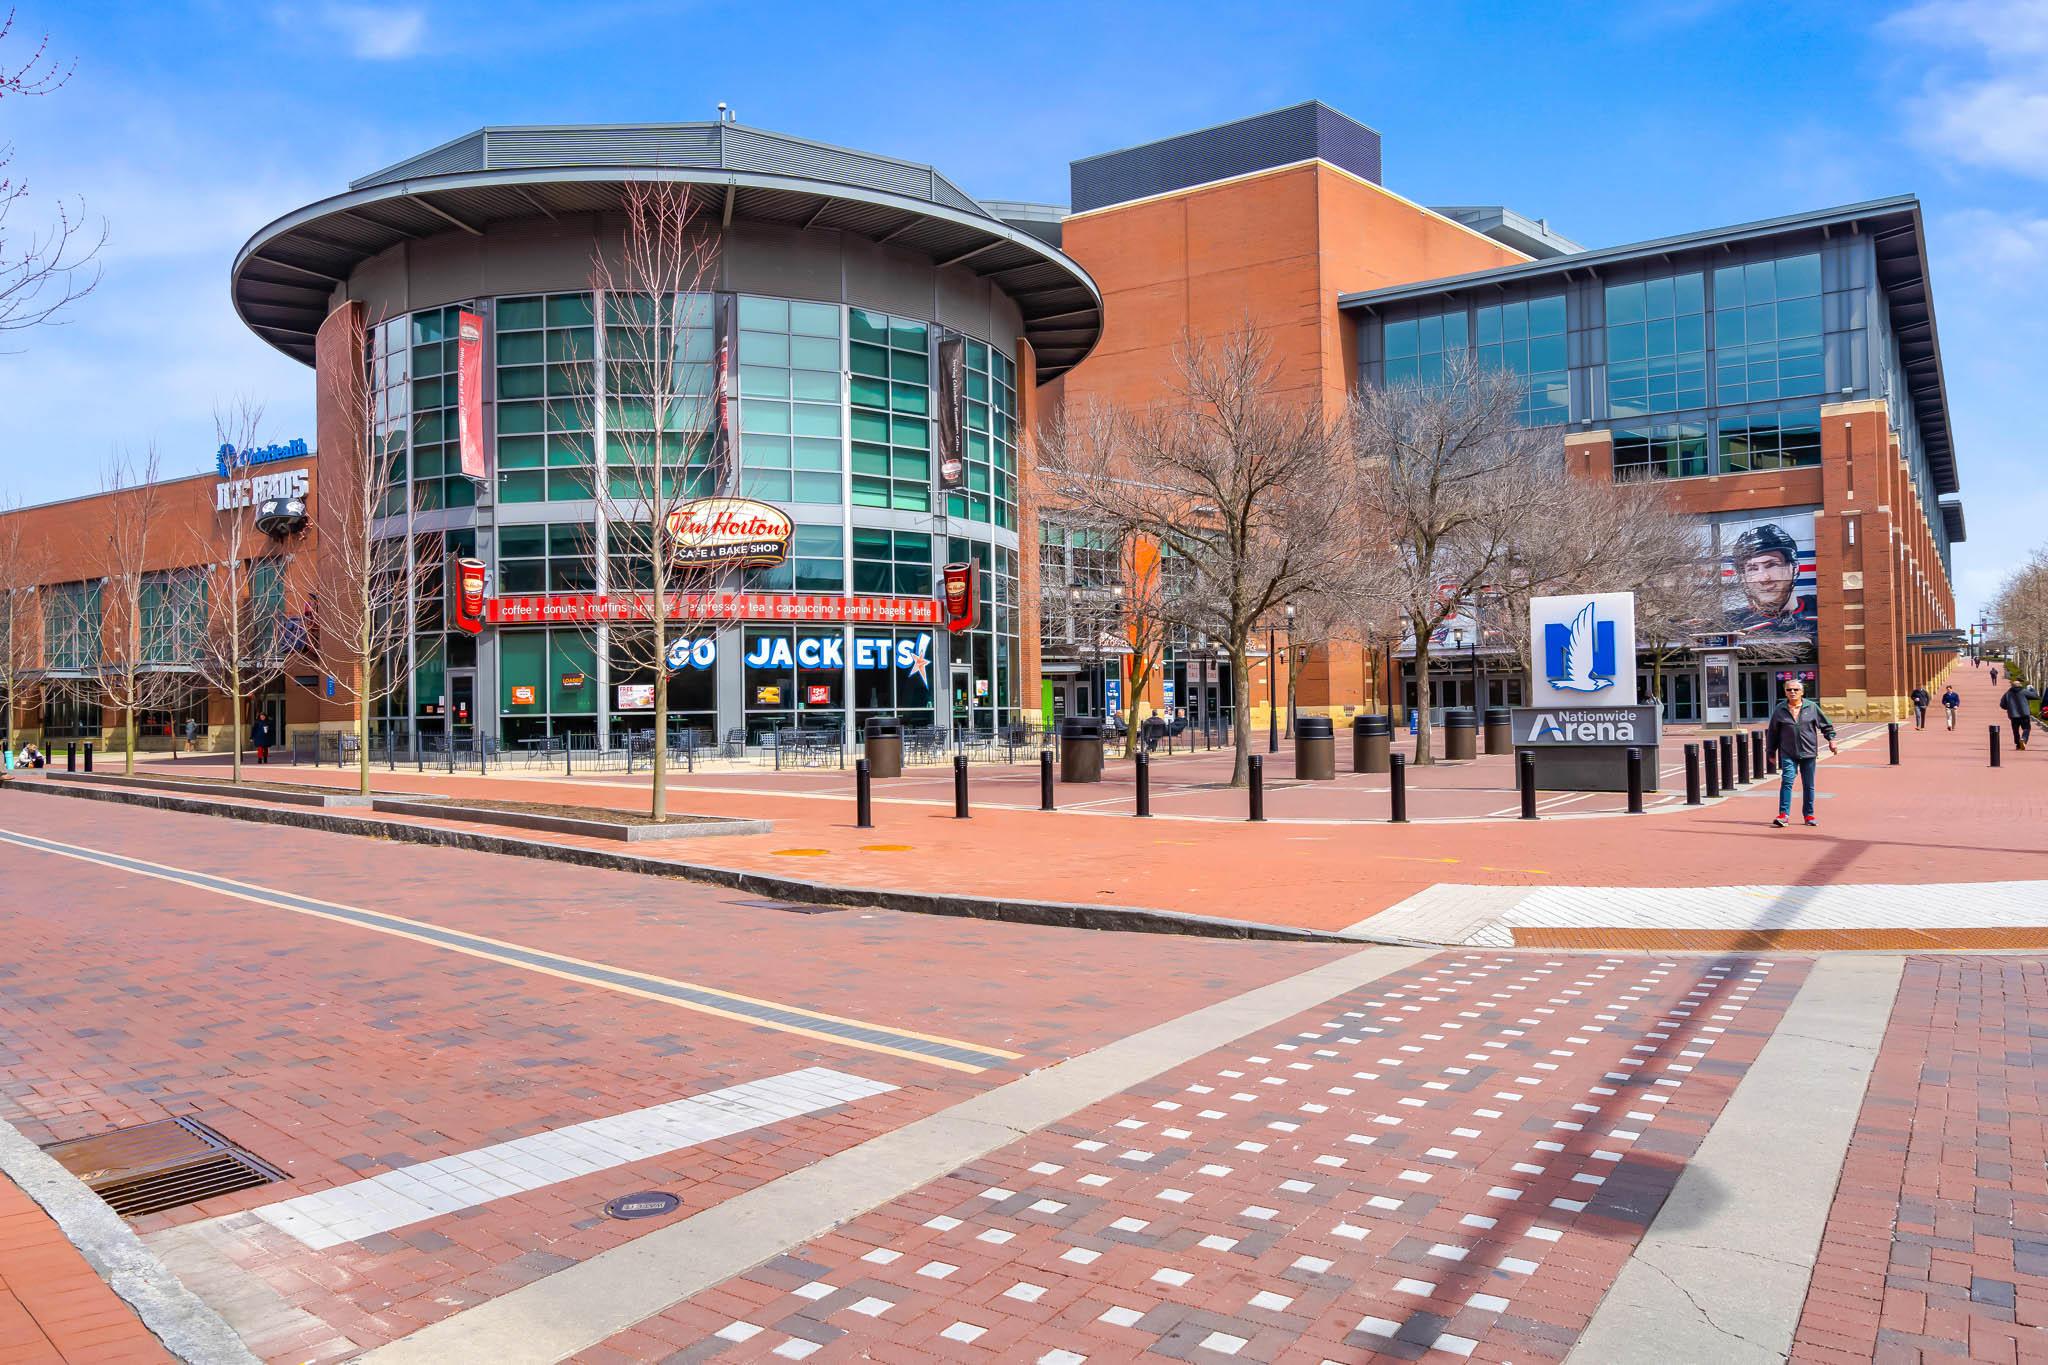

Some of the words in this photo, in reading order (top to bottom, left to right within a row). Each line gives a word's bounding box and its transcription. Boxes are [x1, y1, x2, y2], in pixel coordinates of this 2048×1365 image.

[669, 511, 707, 535] Tim
[711, 511, 789, 536] Hortons
[719, 545, 748, 556] BAKE
[750, 543, 779, 553] SHOP
[502, 606, 532, 615] coffee
[543, 604, 577, 614] donuts
[588, 603, 627, 612] muffins
[749, 603, 765, 612] tea
[776, 603, 834, 615] cappuccino
[844, 605, 871, 616] panini
[879, 605, 906, 617] bagels
[913, 606, 932, 617] latte
[667, 638, 716, 669] GO
[1558, 710, 1637, 722] Nationwide
[1527, 713, 1634, 742] Arena
